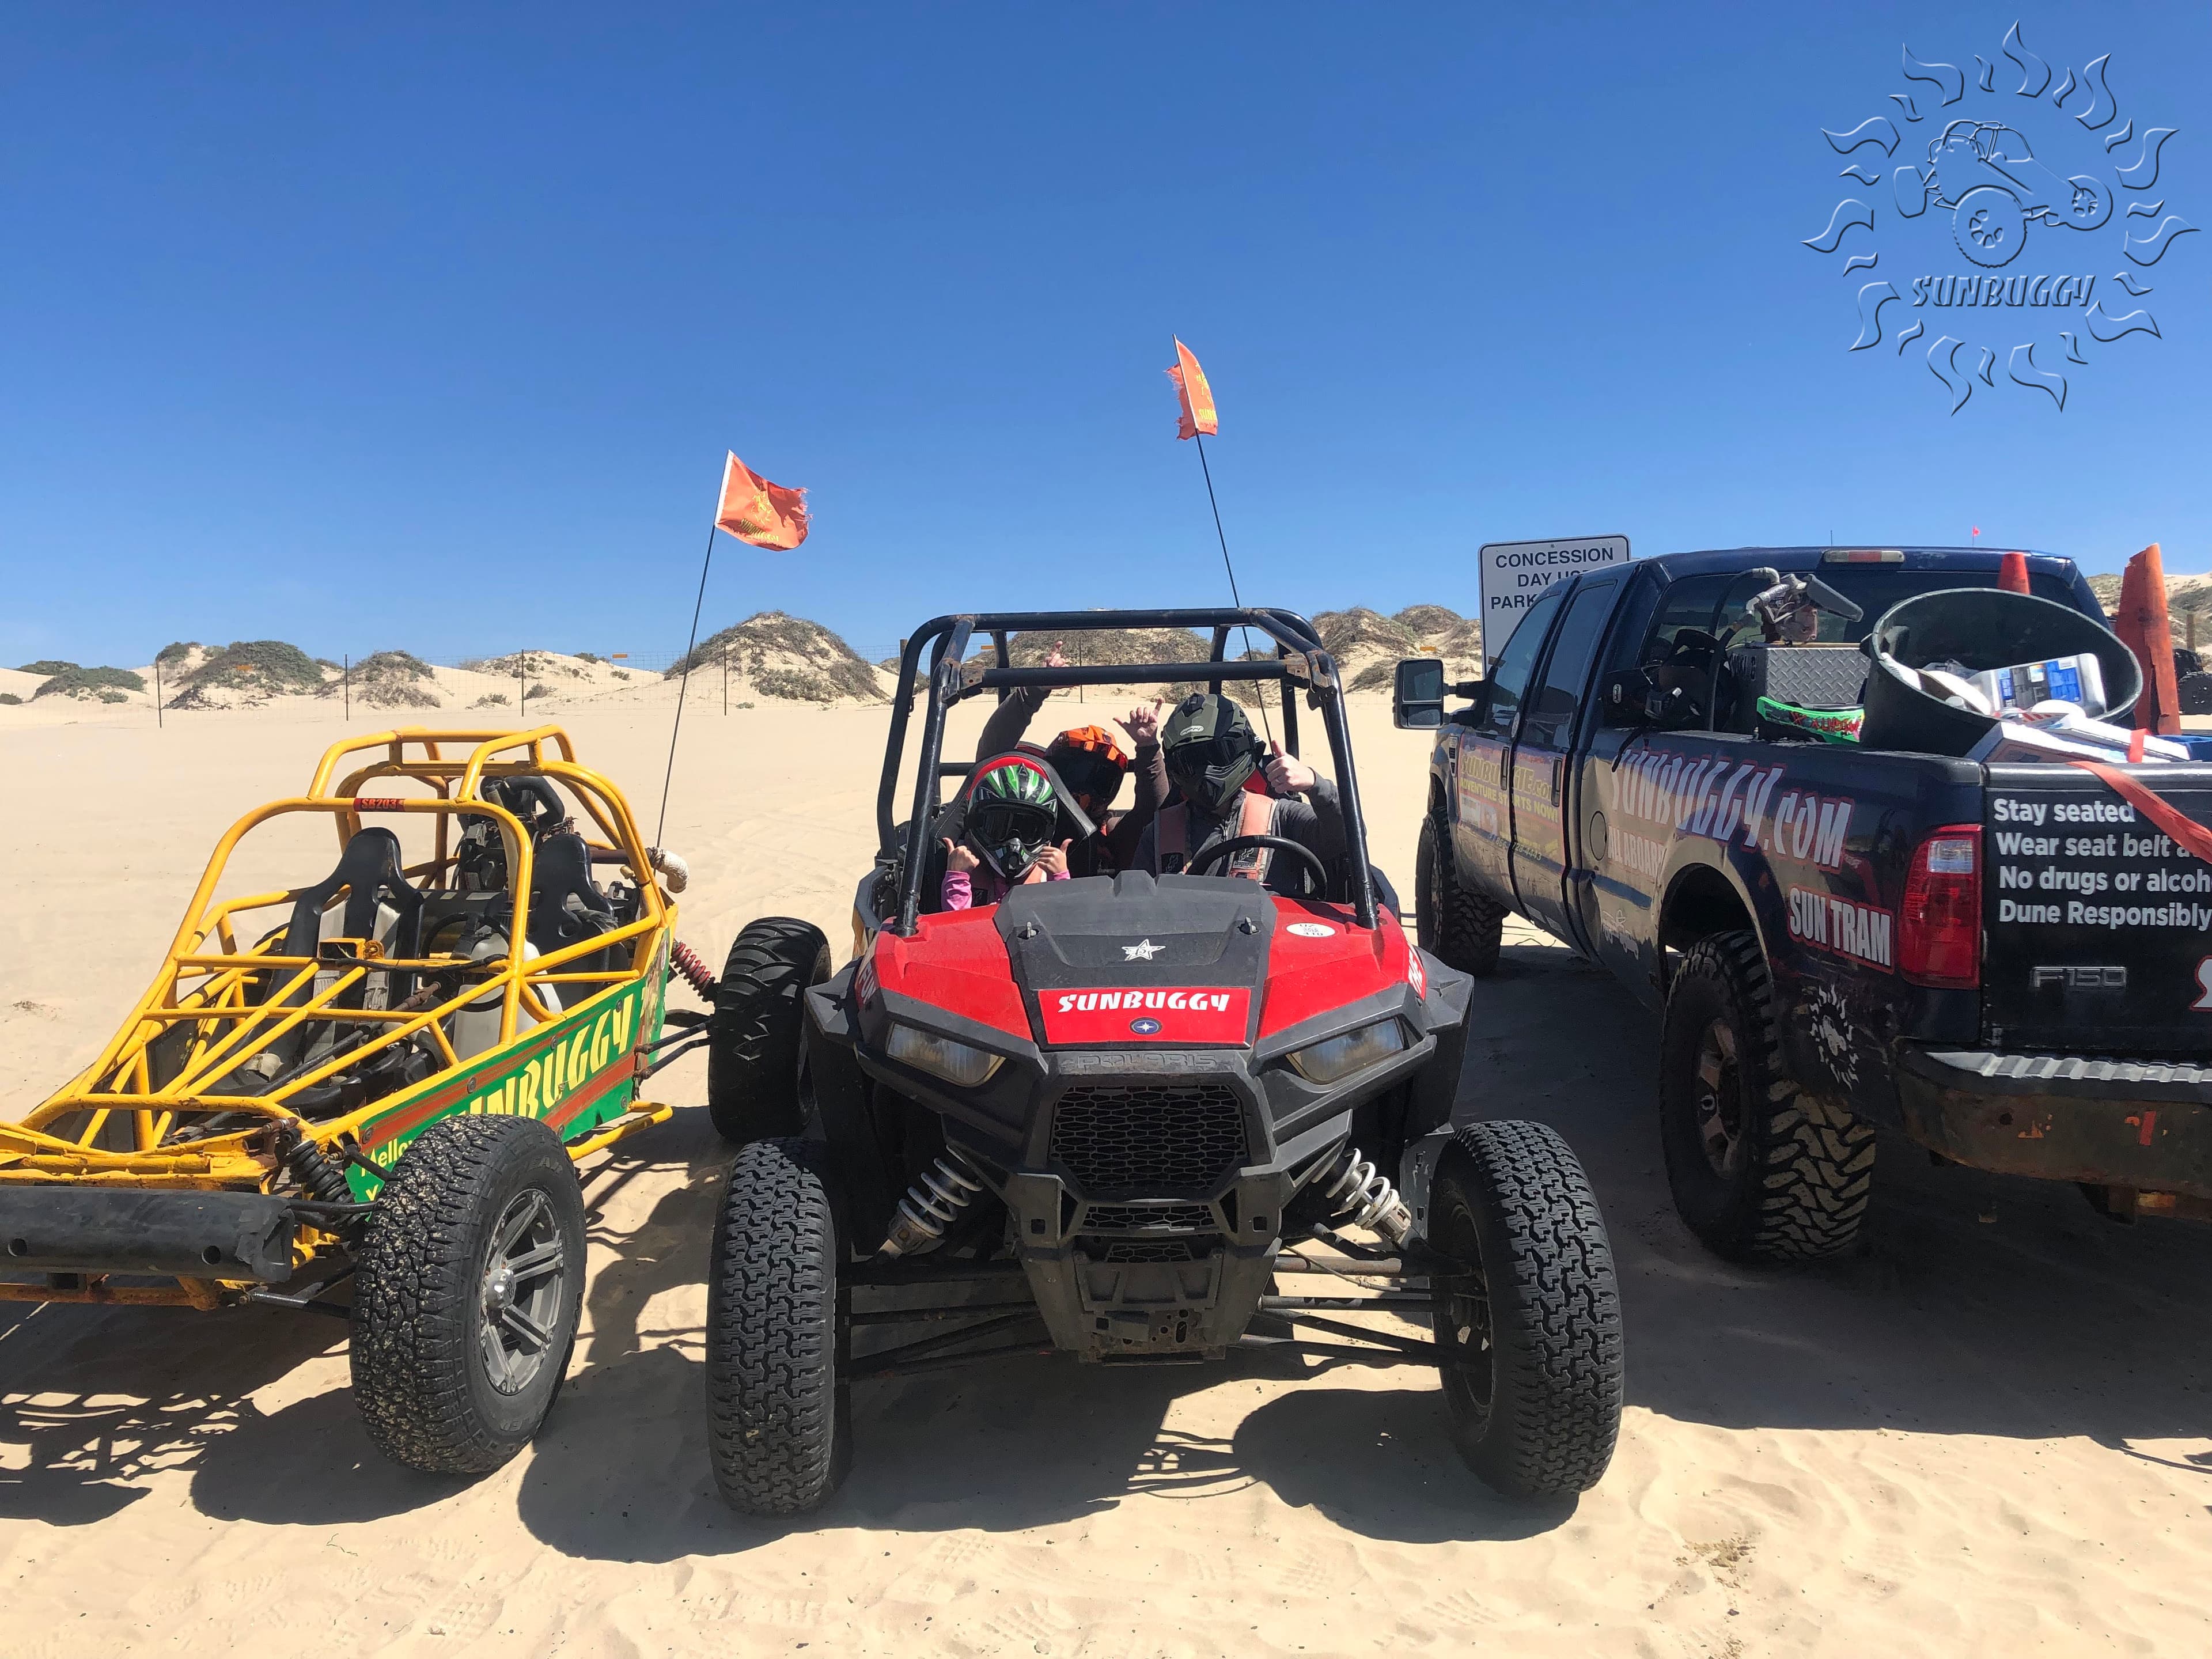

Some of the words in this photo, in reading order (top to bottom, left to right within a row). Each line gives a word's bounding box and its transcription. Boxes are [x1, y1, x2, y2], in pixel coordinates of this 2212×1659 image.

[1496, 547, 1613, 568] CONCESSION
[1517, 572, 1552, 587] DAY
[1491, 594, 1537, 609] PARK
[361, 798, 397, 809] SB203
[1460, 777, 1497, 801] ADVENTURE
[1498, 791, 1532, 812] STRTS
[1993, 798, 2047, 826] Stay
[2054, 800, 2135, 823] seated
[1607, 825, 1622, 863] ALL
[1995, 832, 2060, 856] Wear
[2065, 834, 2117, 857] seat
[2123, 833, 2171, 857] belt
[1999, 866, 2034, 889] No
[2039, 866, 2108, 895] drugs
[2115, 872, 2141, 891] or
[1790, 887, 1827, 944] SUN
[1830, 900, 1891, 966] TRAM
[1999, 899, 2061, 923] Dune
[2067, 901, 2212, 931] Responsibly
[2030, 966, 2127, 987] F-150
[1058, 991, 1230, 1013] SUNBUGGY
[1078, 1053, 1217, 1069] POLARIS
